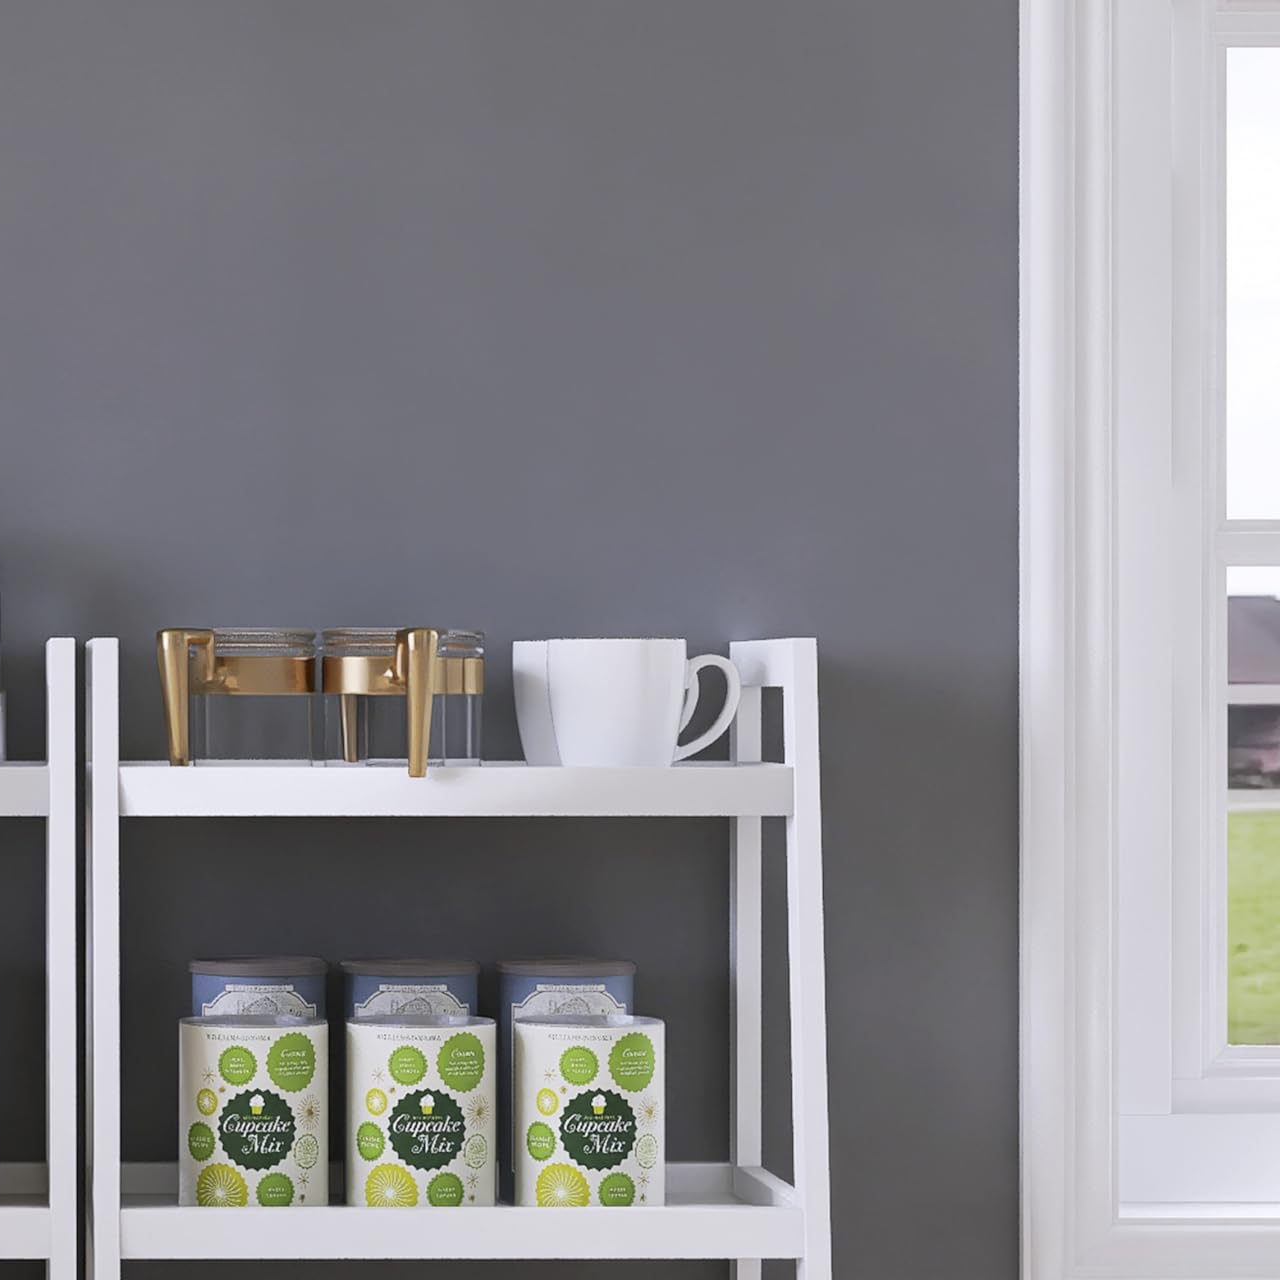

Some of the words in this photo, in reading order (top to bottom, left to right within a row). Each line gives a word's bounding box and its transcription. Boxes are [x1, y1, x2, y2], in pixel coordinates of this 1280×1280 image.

[222, 1113, 291, 1138] Cupcake
[392, 1113, 461, 1138] Cupcake
[563, 1113, 632, 1138] Cupcake
[241, 1133, 285, 1155] Mix
[411, 1133, 455, 1155] Mix
[583, 1133, 626, 1155] Mix
